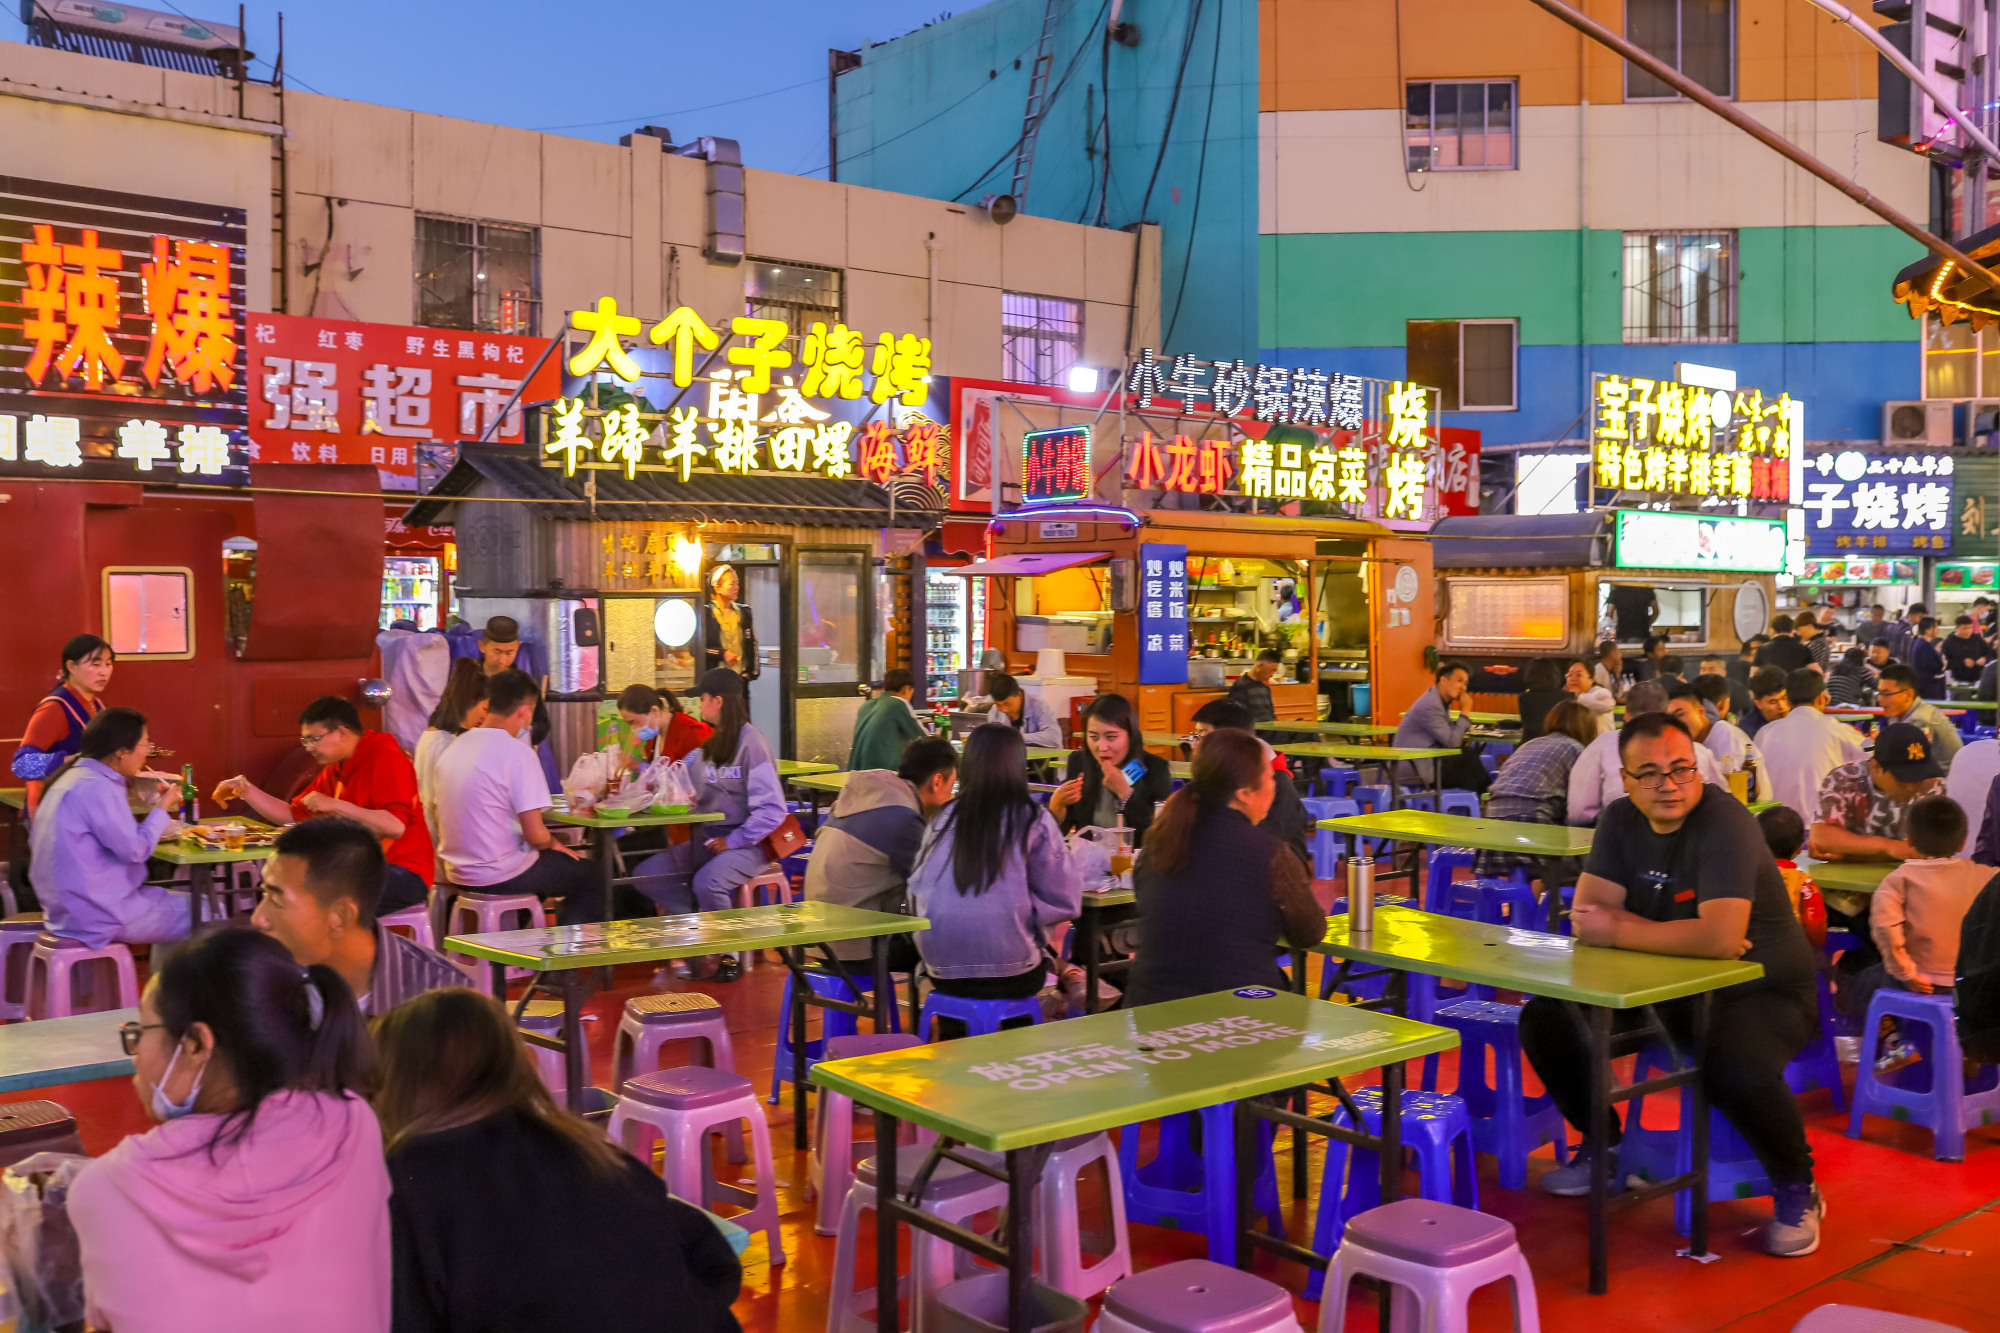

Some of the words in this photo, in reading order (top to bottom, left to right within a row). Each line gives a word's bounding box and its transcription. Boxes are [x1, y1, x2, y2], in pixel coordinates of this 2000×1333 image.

[22, 224, 237, 393] 辣爆
[318, 330, 364, 351] 红枣
[406, 336, 525, 364] 野生黑枸杞
[569, 296, 931, 406] 大个子烧烤
[264, 356, 523, 442] 强超市
[1129, 347, 1364, 430] 小牛砂锅辣爆
[1600, 374, 1712, 450] 宝子烧烤
[118, 419, 230, 475] 羊排
[292, 442, 338, 464] 饮料
[1128, 430, 1232, 495] 小龙虾
[1240, 439, 1368, 503] 精品凉菜
[1386, 381, 1427, 520] 烧烤
[1008, 1060, 1133, 1091] OPEN
[1125, 1050, 1192, 1065] TO
[1190, 1025, 1308, 1054] MORE
